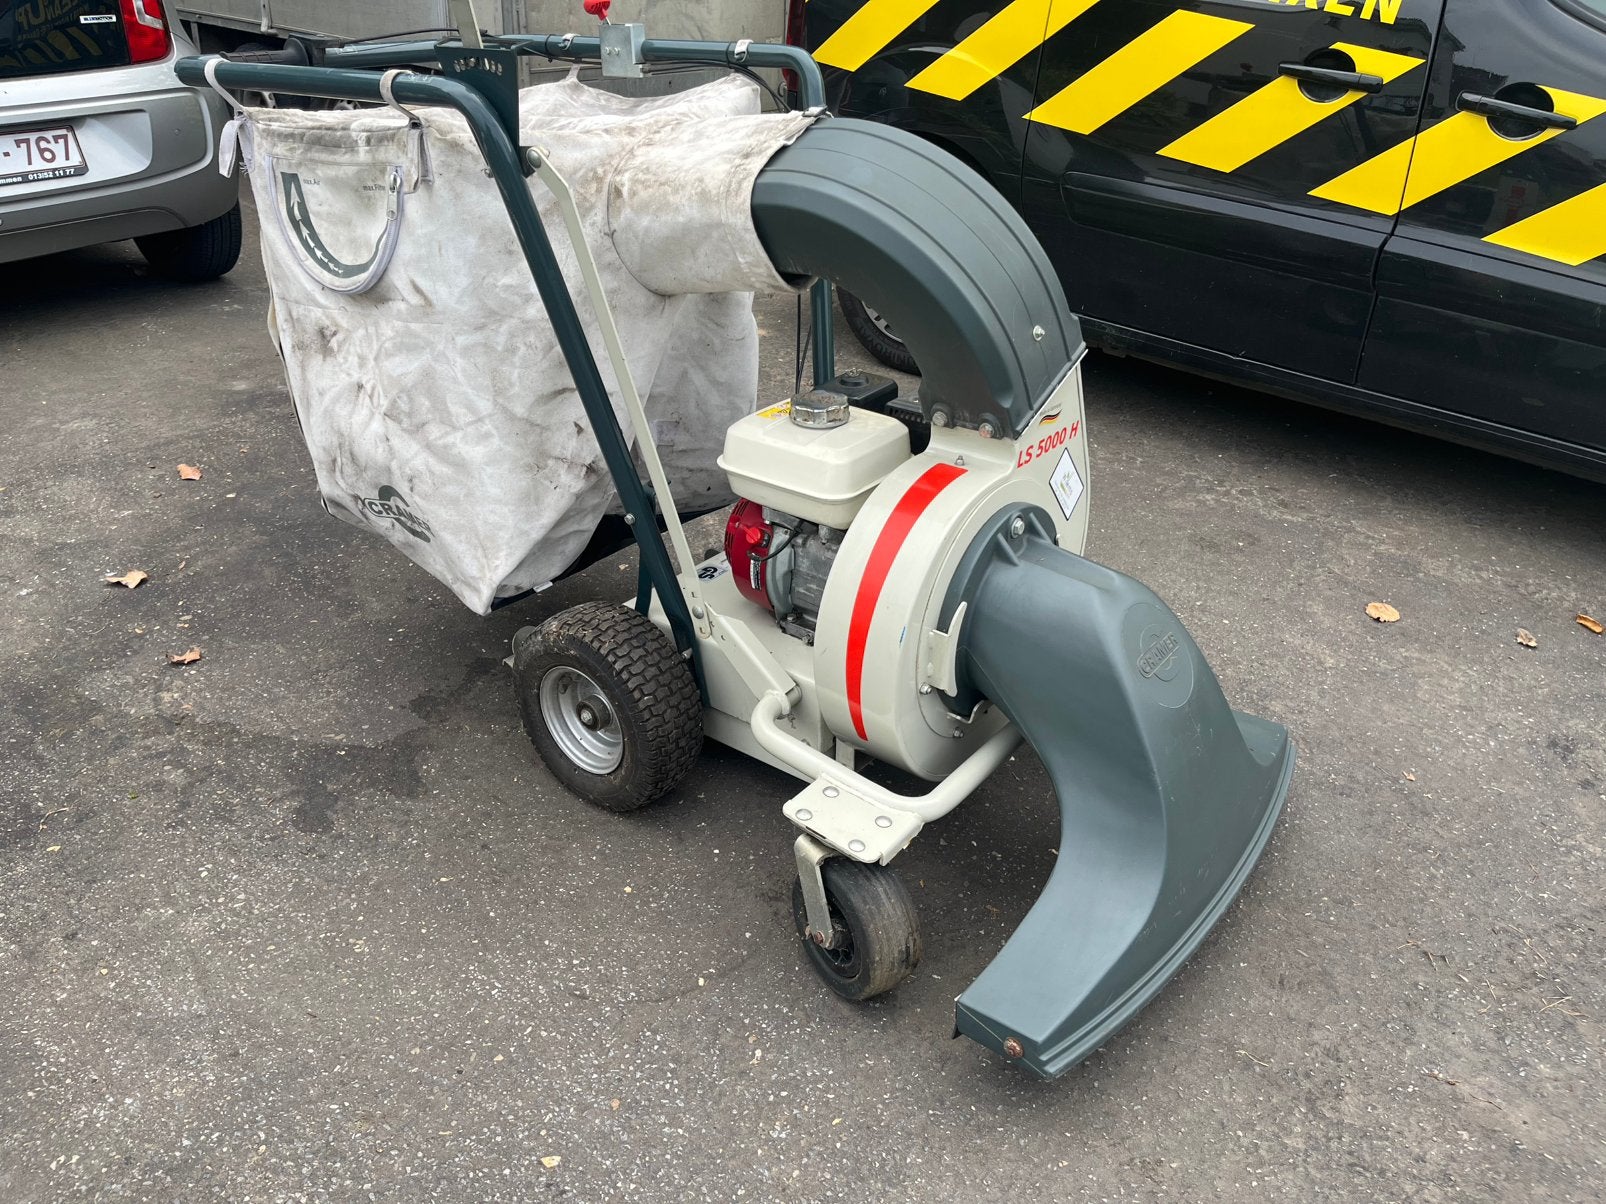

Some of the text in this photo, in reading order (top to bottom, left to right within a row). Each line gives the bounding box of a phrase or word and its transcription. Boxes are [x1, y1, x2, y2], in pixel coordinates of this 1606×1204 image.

[55, 169, 63, 177] 11
[1017, 420, 1080, 468] LS 5000 H
[1139, 633, 1179, 674] CRAMER
